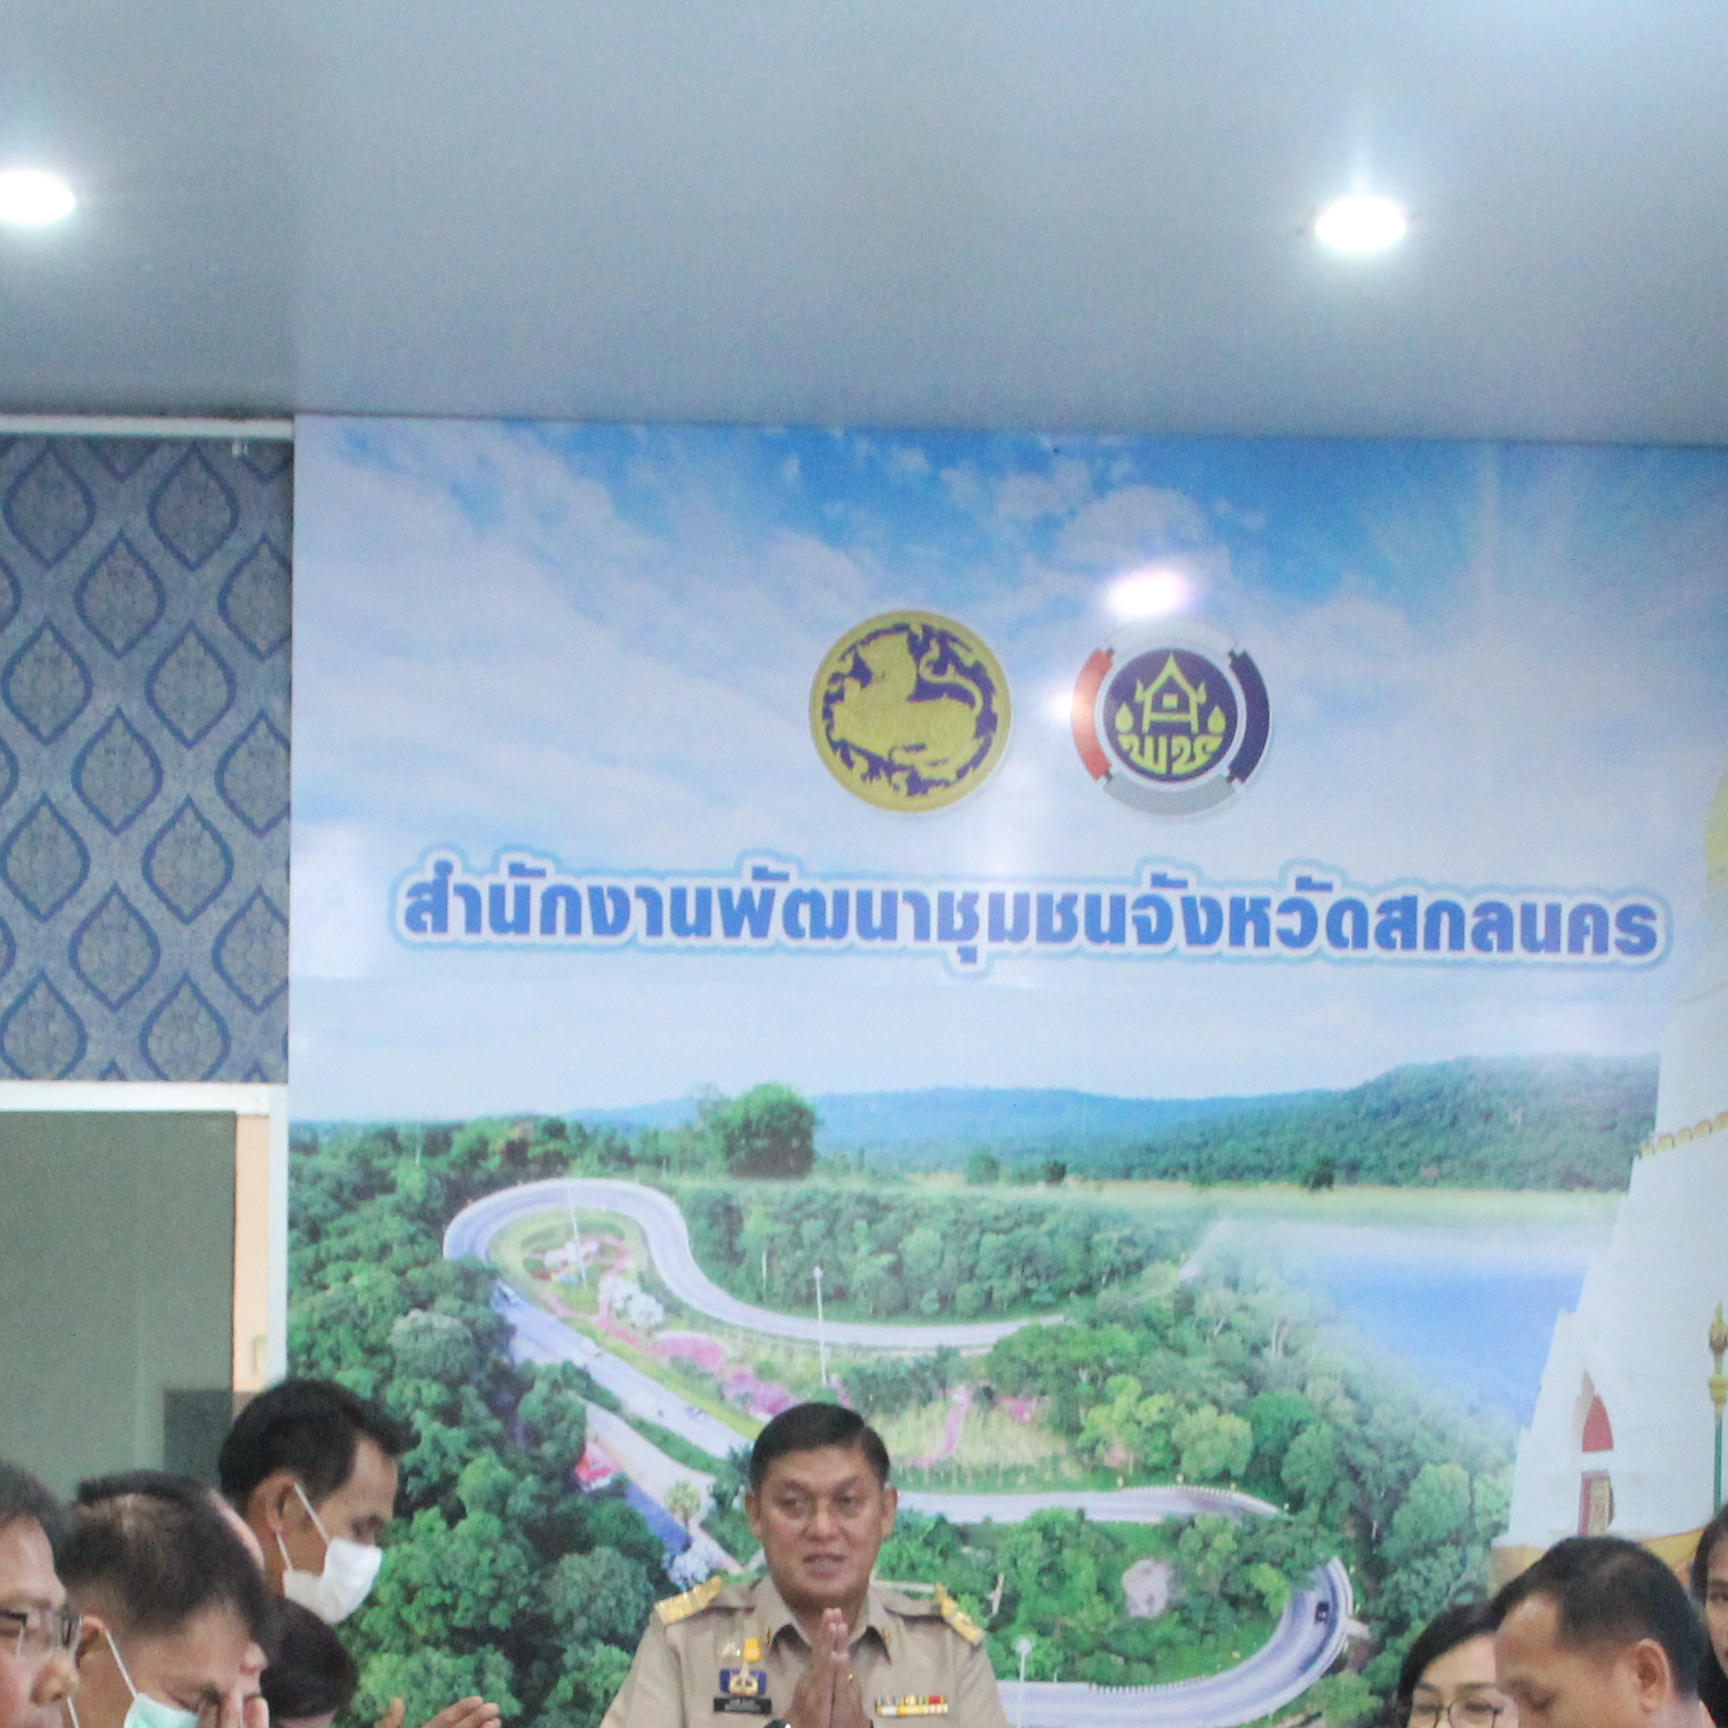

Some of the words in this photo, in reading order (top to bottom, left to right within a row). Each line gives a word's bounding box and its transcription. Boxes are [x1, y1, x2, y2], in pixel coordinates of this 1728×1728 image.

[403, 859, 1659, 965] สำนักงานพัฒนาชุมชนจังหวัดสกลนคร
